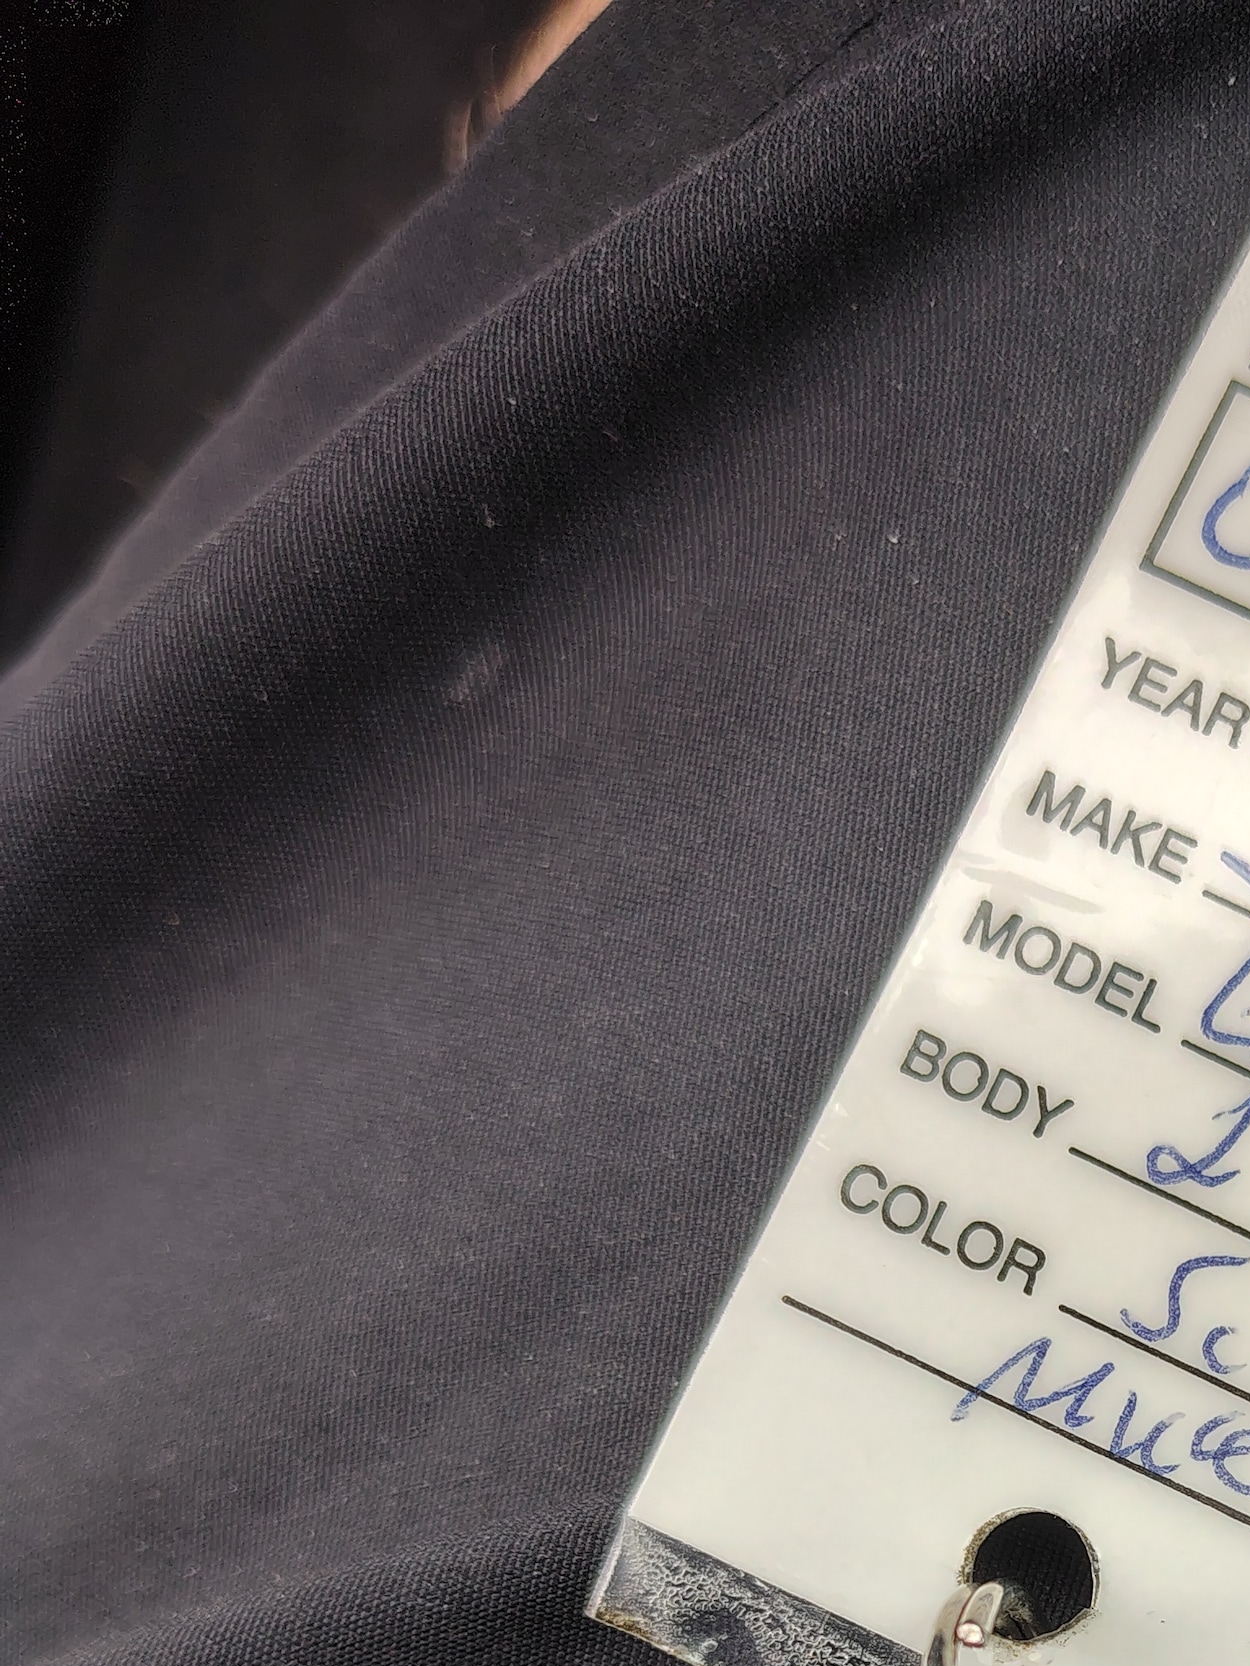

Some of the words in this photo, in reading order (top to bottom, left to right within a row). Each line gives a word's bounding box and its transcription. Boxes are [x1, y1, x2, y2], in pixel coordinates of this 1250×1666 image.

[1025, 770, 1199, 884] MAKE
[962, 898, 1163, 1034] MODEL
[898, 1028, 1076, 1140] BODY
[838, 1163, 1048, 1297] COLOR
